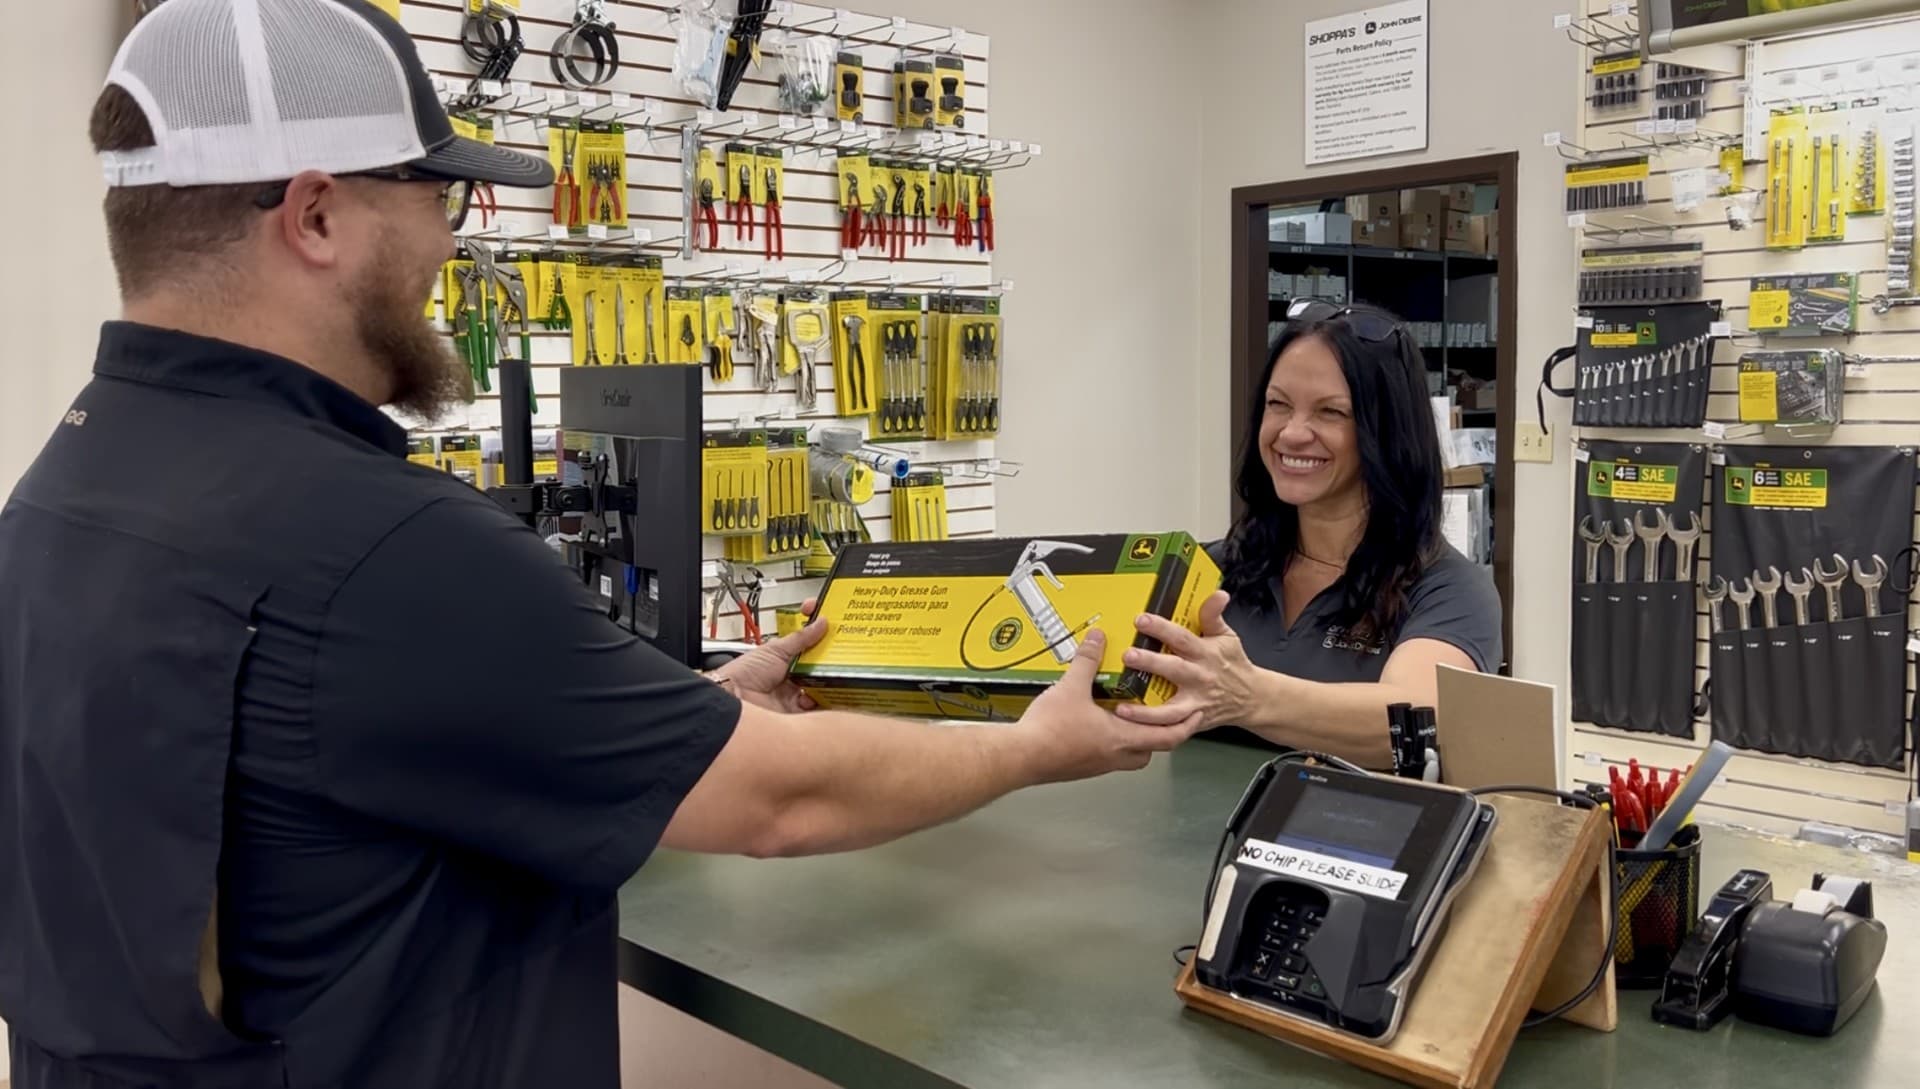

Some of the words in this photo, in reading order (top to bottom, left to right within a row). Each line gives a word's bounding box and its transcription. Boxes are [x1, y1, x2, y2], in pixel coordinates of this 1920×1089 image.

[1379, 20, 1398, 30] JOHN
[1398, 15, 1422, 26] DEERE
[1309, 27, 1356, 46] SHOPPA'S
[1336, 47, 1351, 55] Parts
[1353, 43, 1373, 51] Return
[1374, 39, 1392, 48] Policy
[1615, 466, 1624, 480] 4
[1641, 468, 1665, 482] SAE
[1754, 471, 1764, 485] 6
[1784, 472, 1812, 486] SAE
[853, 586, 899, 597] Heavy-Duty
[900, 586, 930, 596] Grease
[930, 586, 948, 595] Gun
[848, 600, 875, 610] Pistola
[875, 601, 927, 611] engrasadora
[927, 602, 949, 611] para
[843, 613, 874, 621] servicio
[874, 613, 902, 621] severo
[837, 625, 908, 637] Pistolet-graisseur
[909, 627, 941, 636] robuste
[1240, 845, 1263, 859] NO
[1265, 850, 1297, 868] CHIP
[1298, 858, 1357, 883] PLEASE
[1356, 872, 1401, 890] SLIDE
